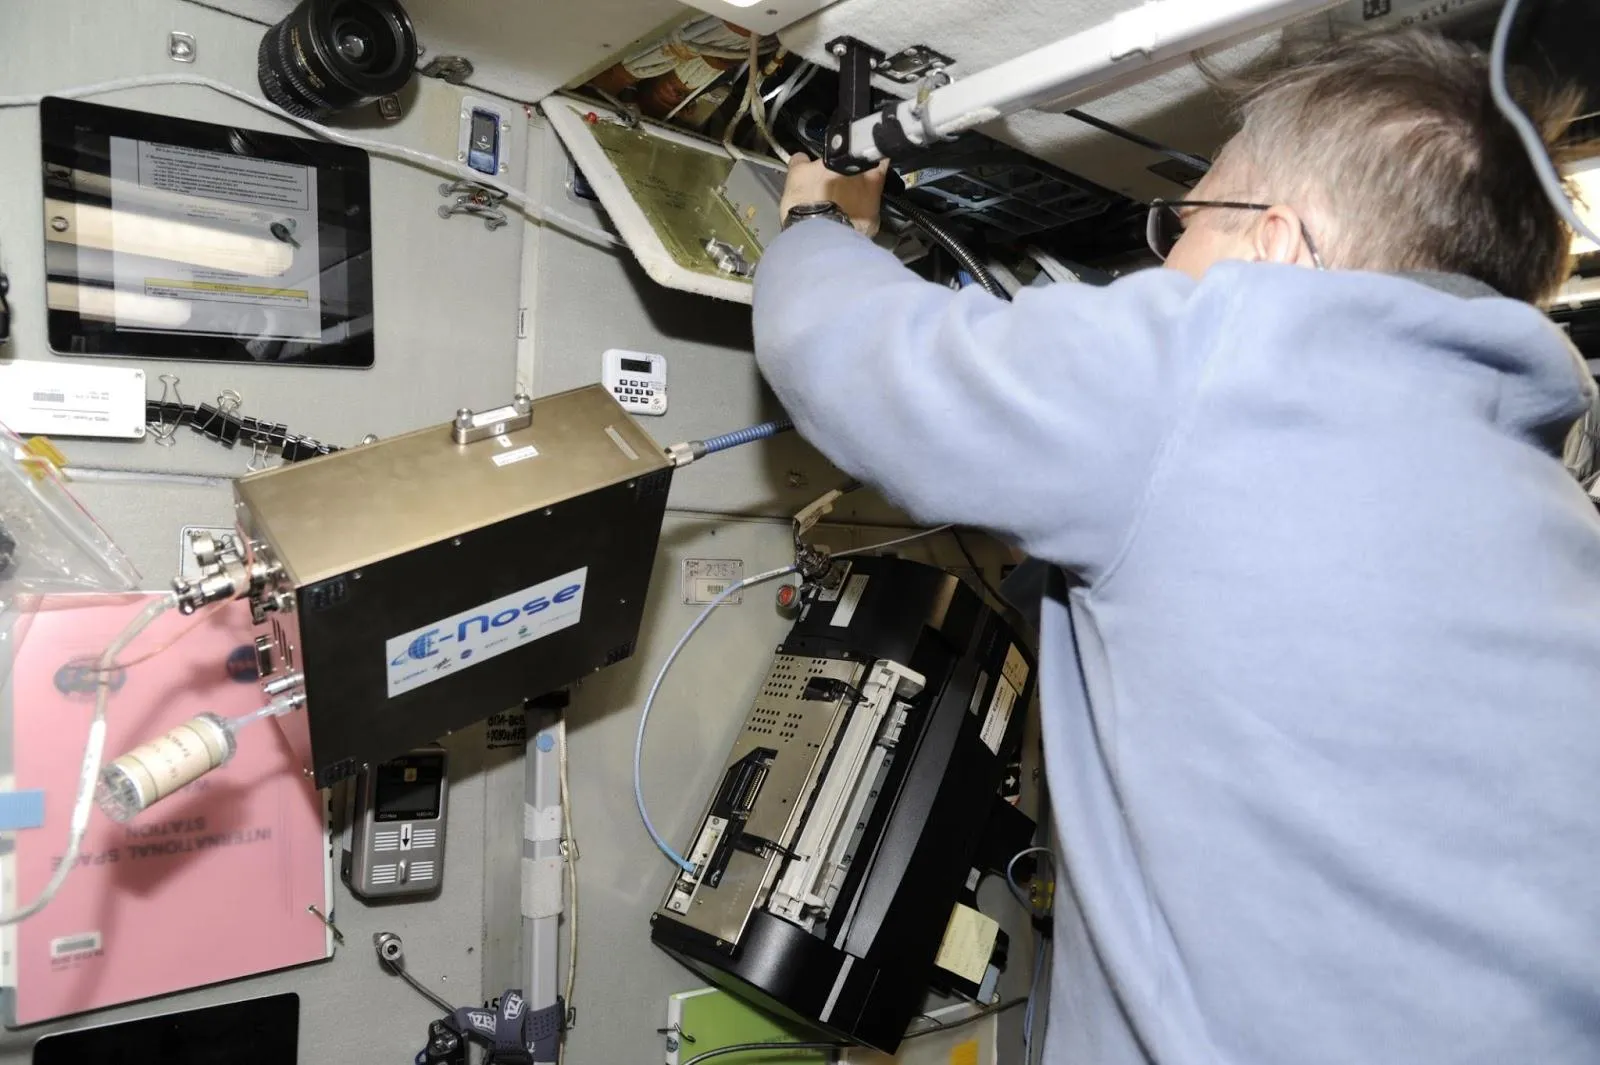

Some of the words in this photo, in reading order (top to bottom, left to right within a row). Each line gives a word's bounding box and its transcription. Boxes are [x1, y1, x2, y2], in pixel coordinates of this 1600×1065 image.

[126, 815, 206, 841] STATION
[127, 827, 272, 861] INTERNATIONAL
[51, 847, 121, 872] SPAE
